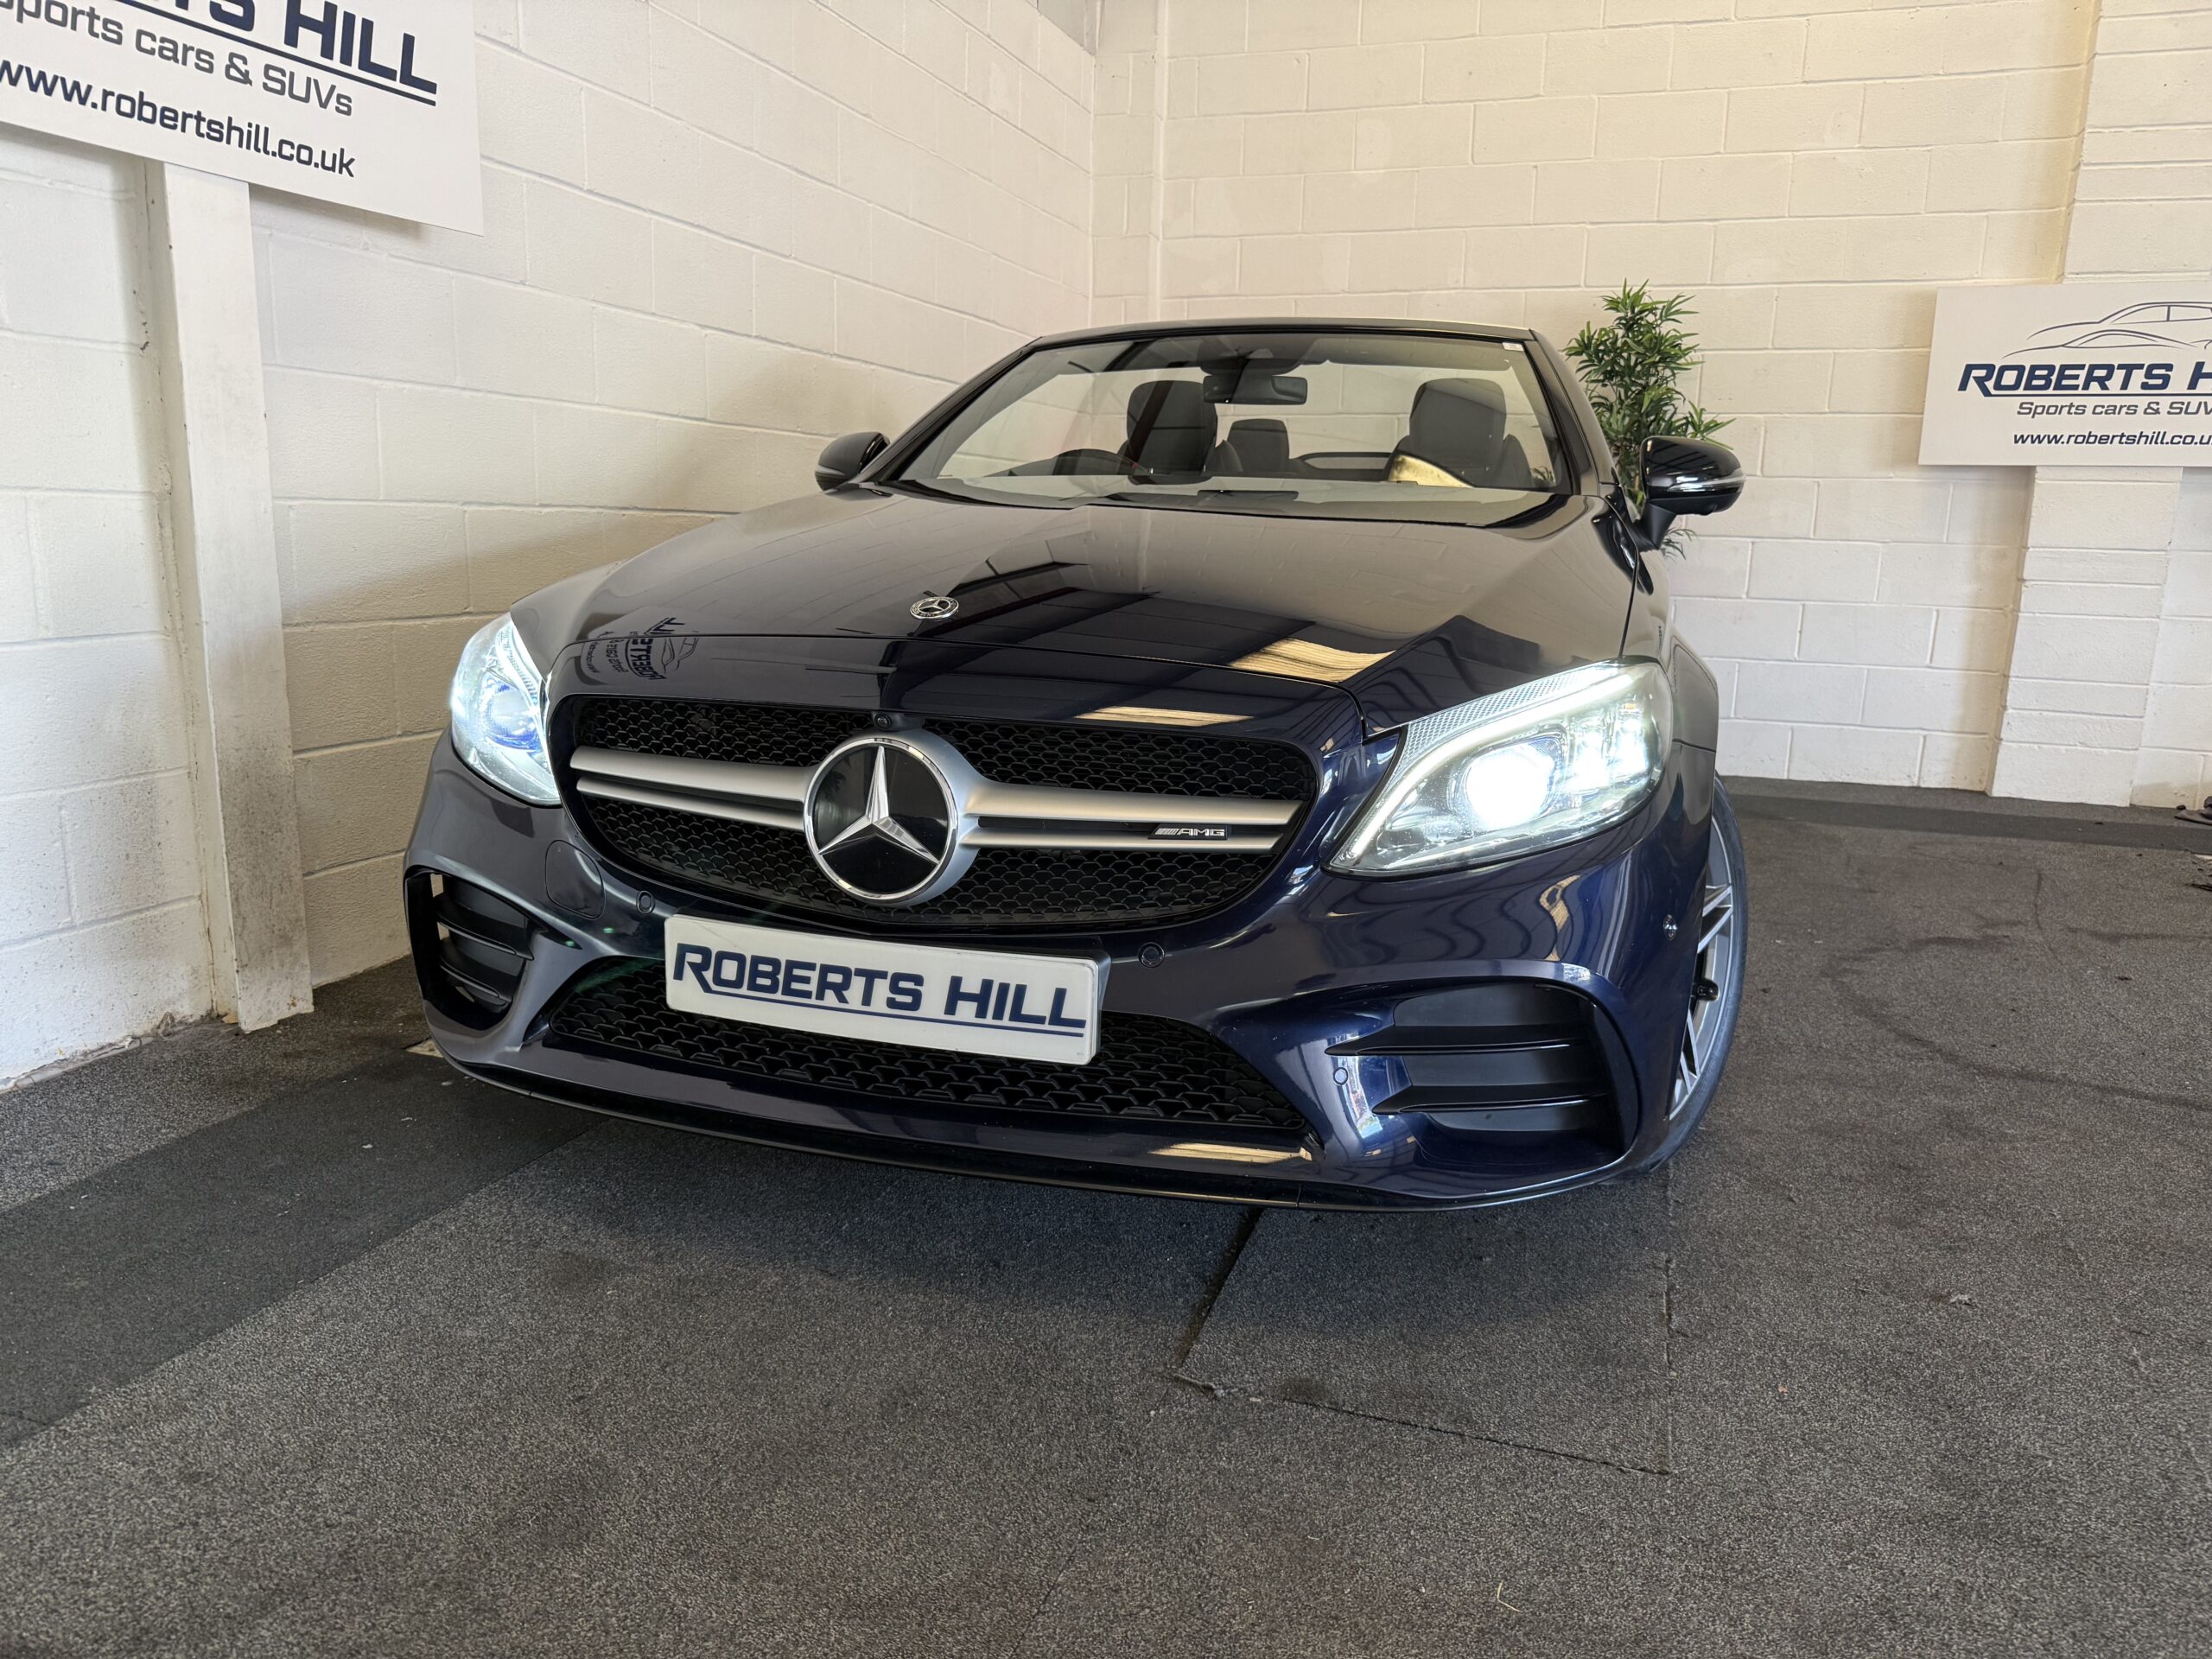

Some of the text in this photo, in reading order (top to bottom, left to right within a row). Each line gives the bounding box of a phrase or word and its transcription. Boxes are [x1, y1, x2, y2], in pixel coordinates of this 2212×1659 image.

[135, 29, 214, 74] cars
[225, 52, 253, 86] &
[263, 63, 353, 116] SUVs
[284, 0, 437, 95] HILL
[0, 60, 356, 178] www.robertshill.co.uk
[1957, 363, 2174, 397] ROBERTS
[2017, 401, 2087, 418] Sports
[2091, 404, 2139, 416] cars
[2143, 401, 2161, 415] &
[2013, 430, 2212, 445] www.robertshill.co.u
[1177, 828, 1225, 836] AMG
[673, 943, 1087, 1028] ROBERTS HILL
